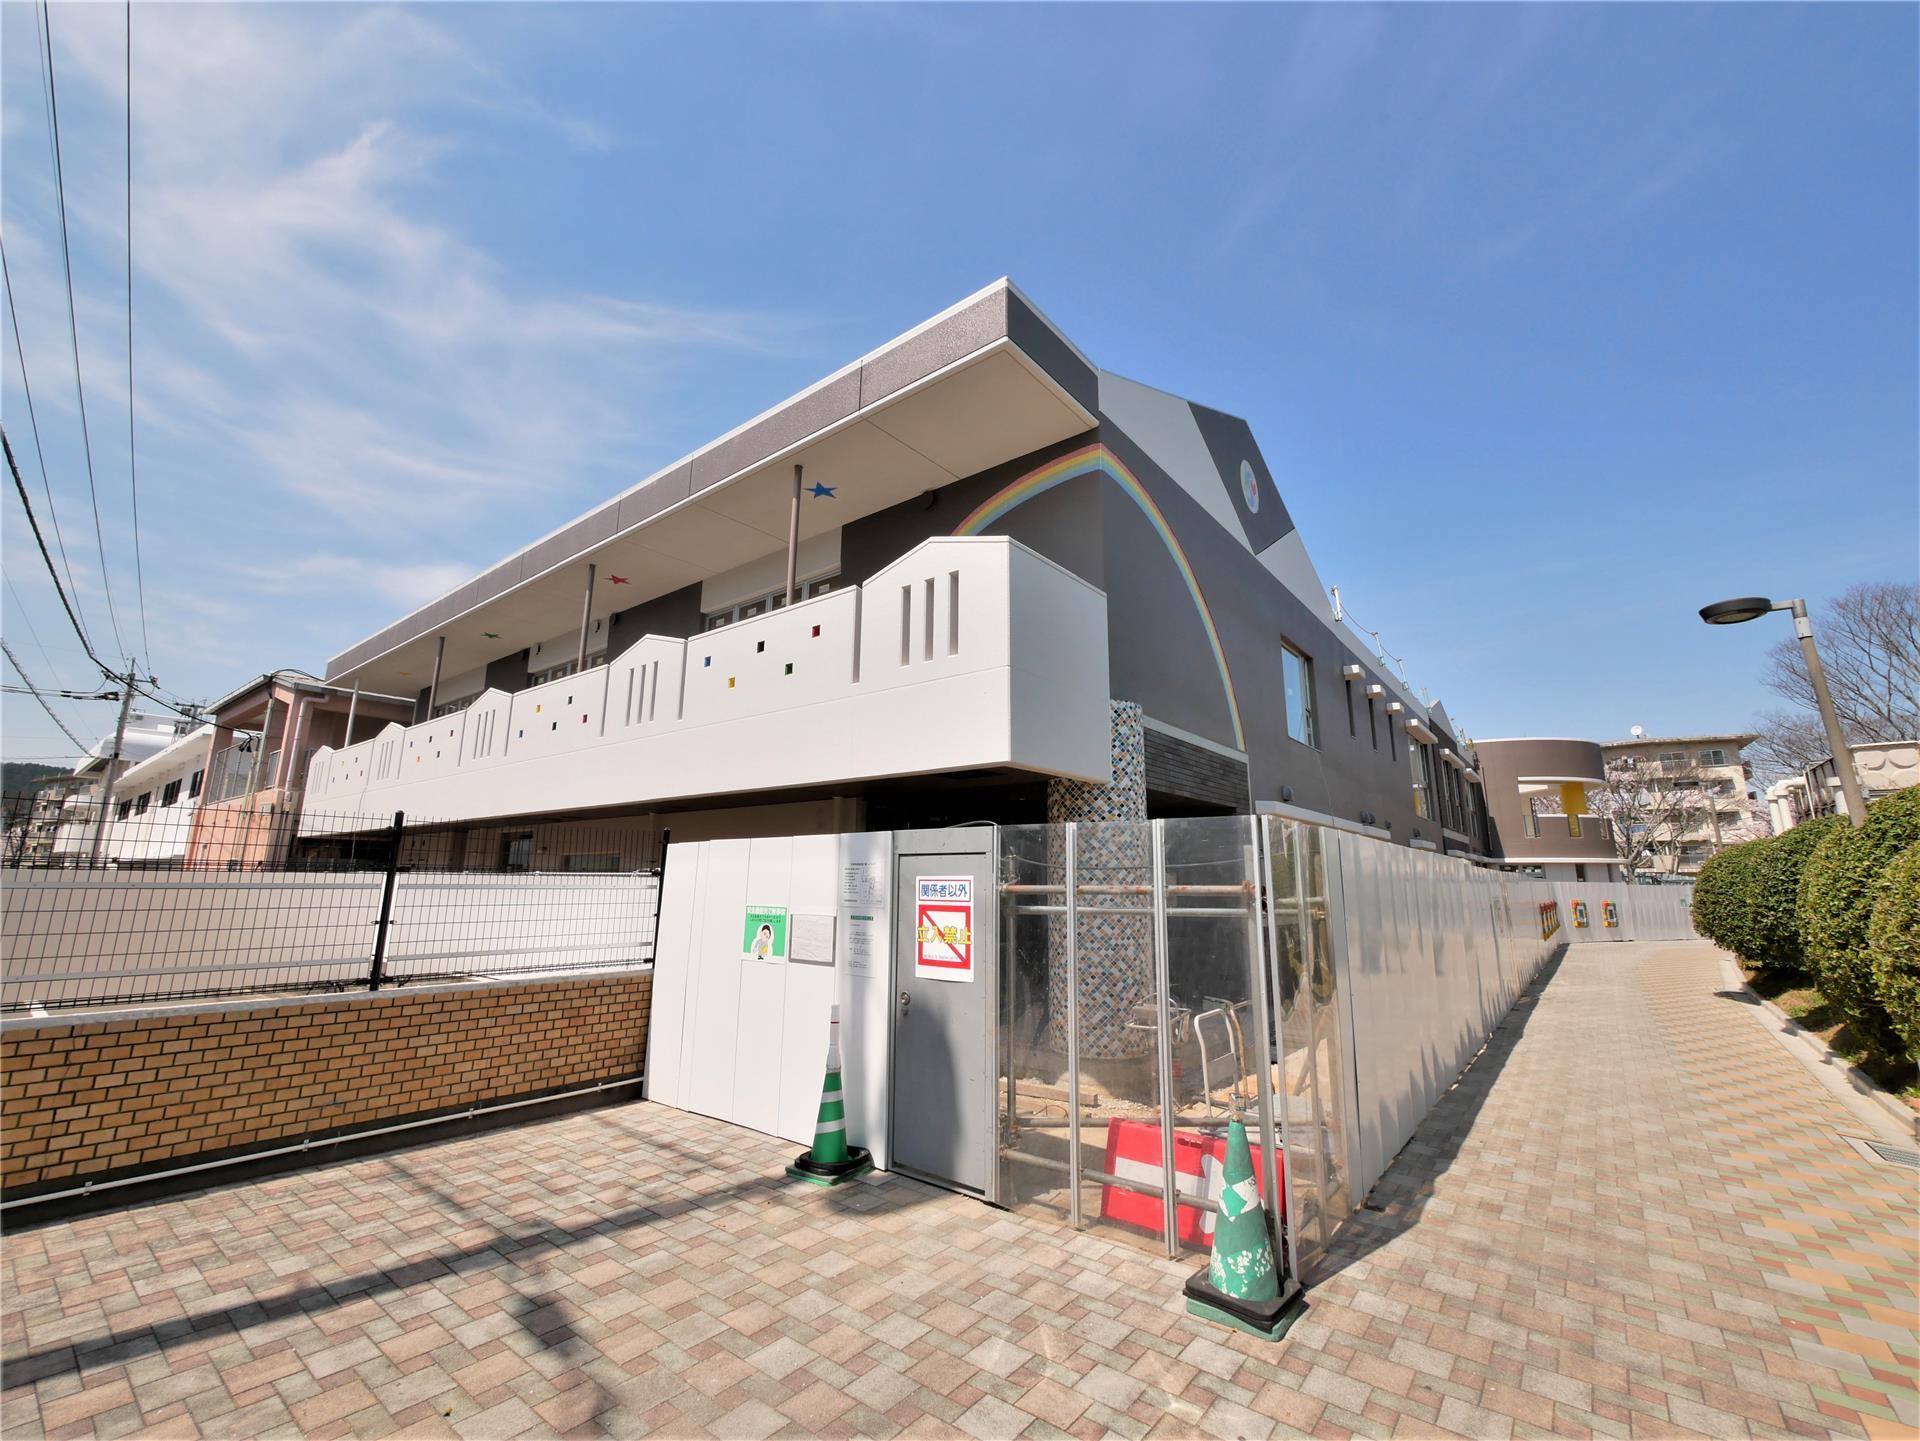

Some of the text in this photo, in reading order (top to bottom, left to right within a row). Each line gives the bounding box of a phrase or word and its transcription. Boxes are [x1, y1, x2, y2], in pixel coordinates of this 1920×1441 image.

[921, 884, 968, 898] 関係者以外
[917, 925, 972, 944] 立入禁止
